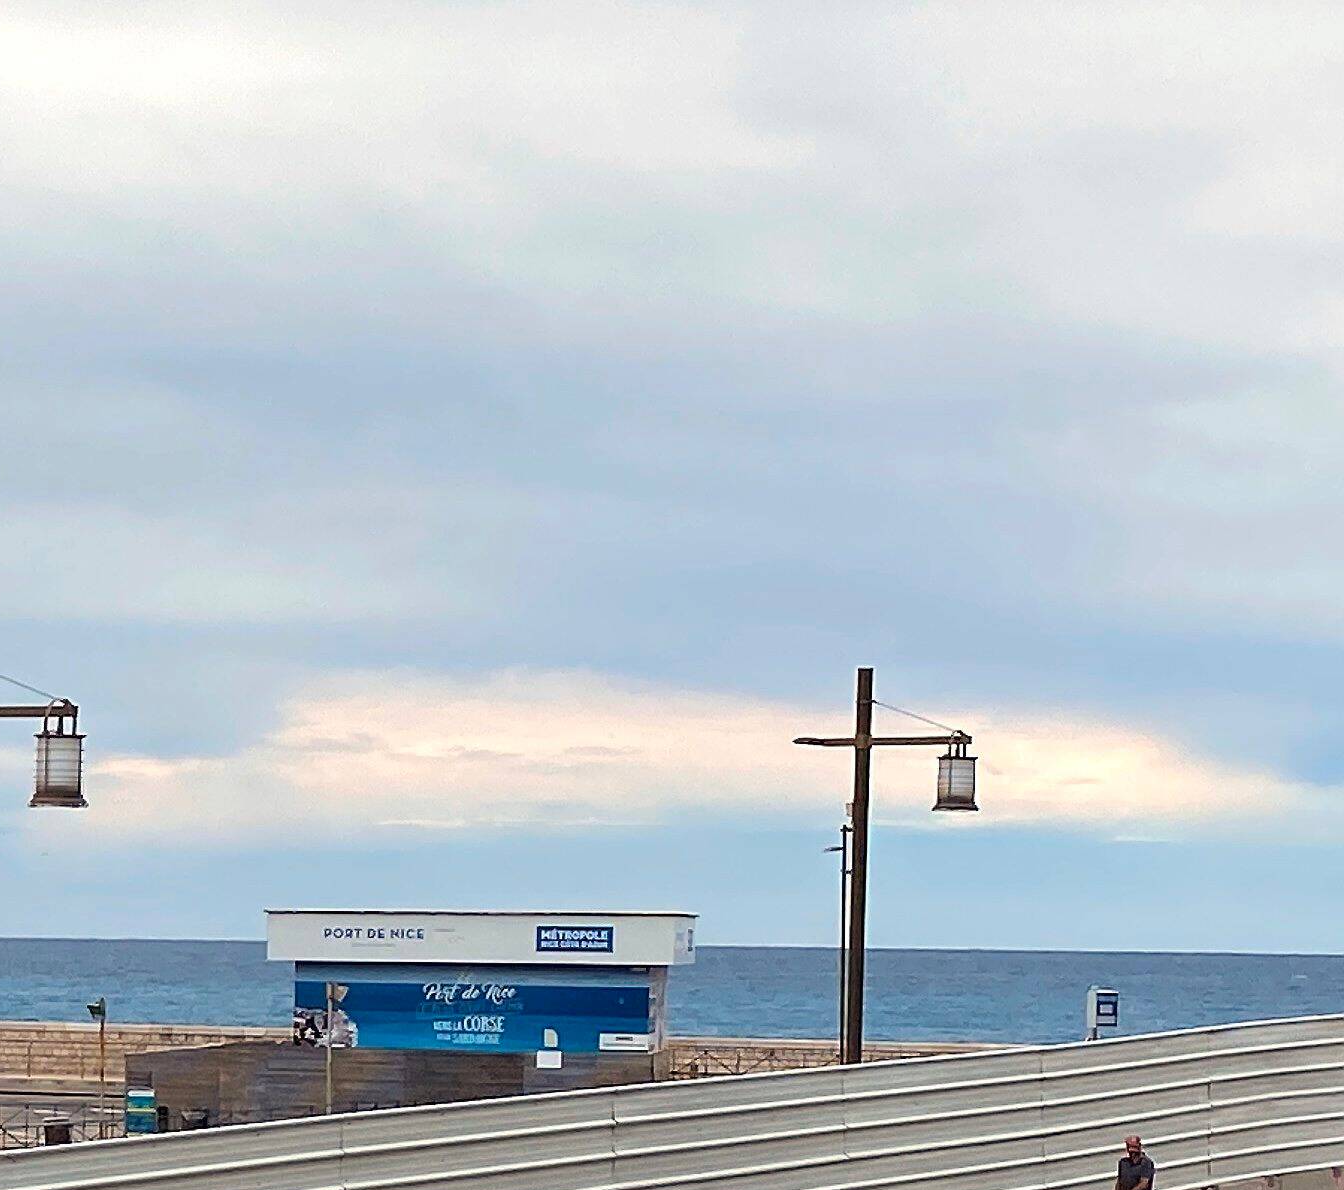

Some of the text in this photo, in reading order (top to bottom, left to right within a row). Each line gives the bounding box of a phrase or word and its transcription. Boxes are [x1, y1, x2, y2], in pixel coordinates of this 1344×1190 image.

[323, 927, 424, 940] PORT DE NICE
[423, 983, 461, 1005] Port
[462, 984, 480, 1000] de
[463, 1016, 505, 1032] CORSE
